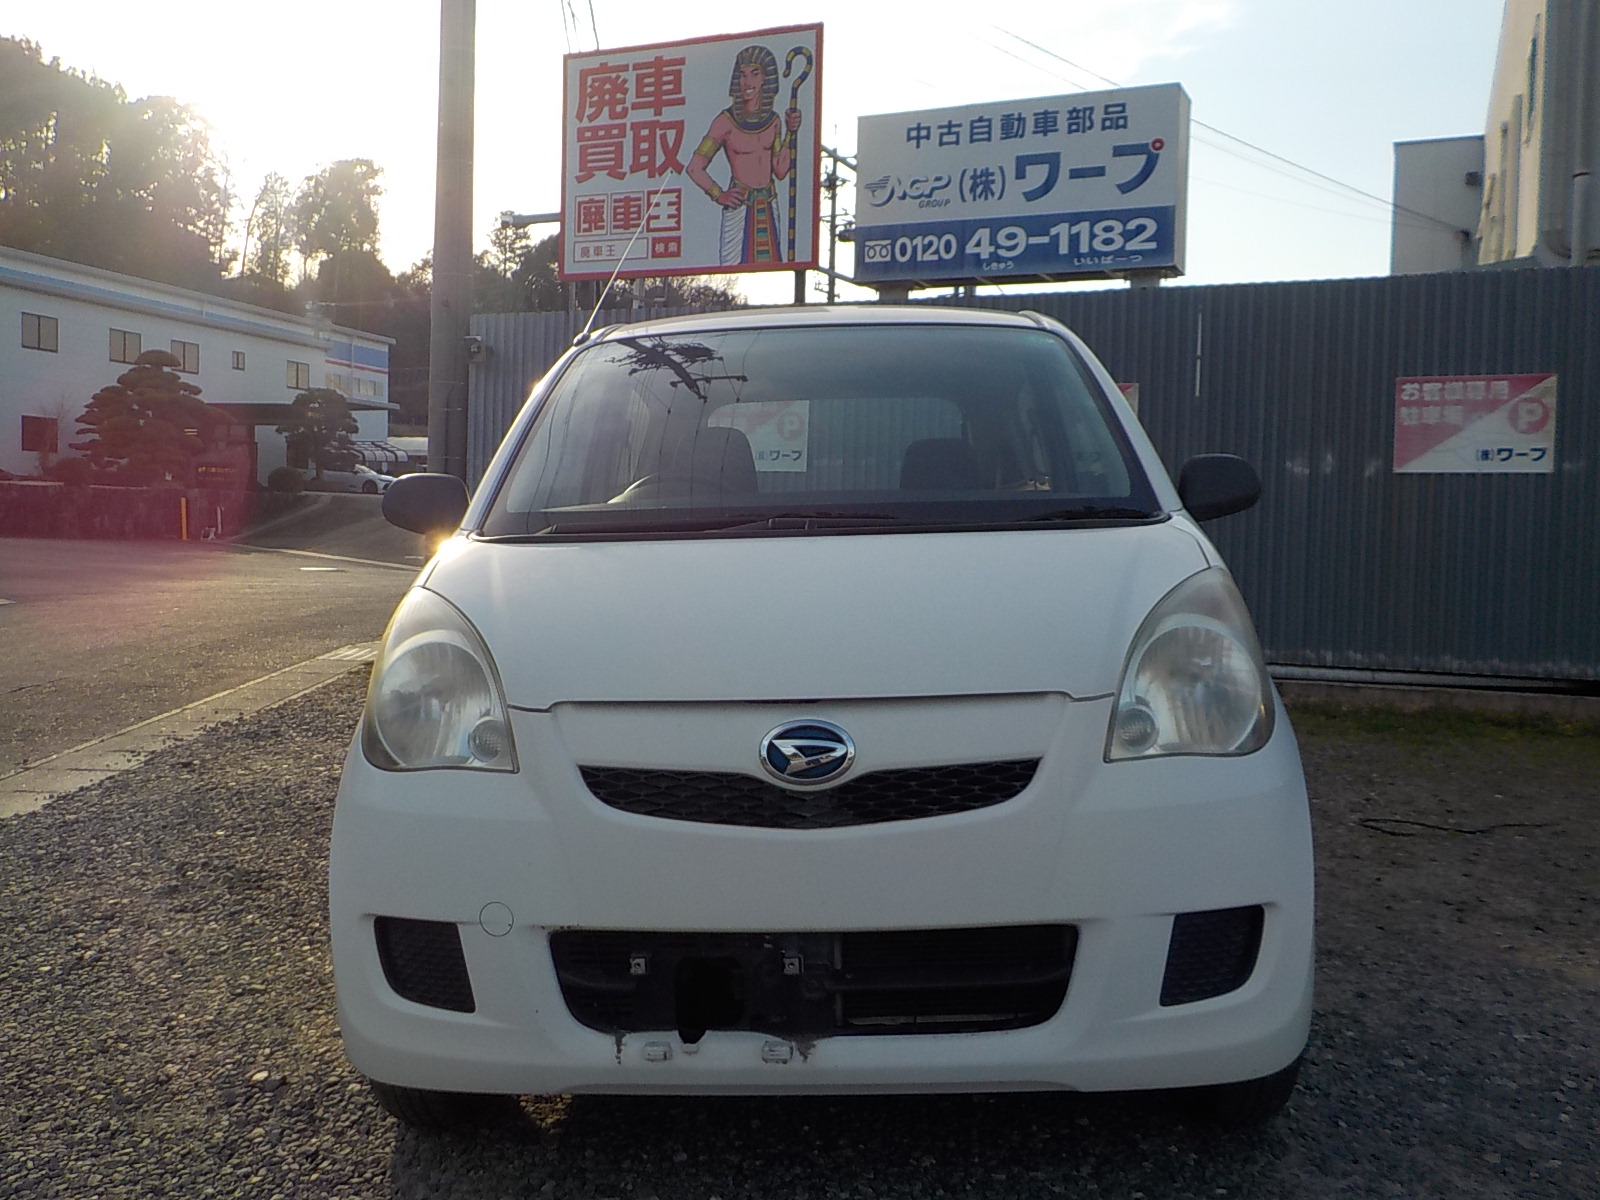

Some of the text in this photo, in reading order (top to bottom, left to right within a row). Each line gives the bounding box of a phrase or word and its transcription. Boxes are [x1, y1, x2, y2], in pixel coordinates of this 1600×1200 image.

[575, 55, 686, 123] 廃車
[906, 102, 1128, 149] 中古自動車部品
[575, 120, 686, 184] 買取
[959, 137, 1165, 202] (株)ワープ
[576, 188, 682, 234] 廃車王
[918, 198, 951, 208] GROUP
[580, 244, 615, 258] 廃車王
[895, 217, 1158, 262] 0120 49-1182
